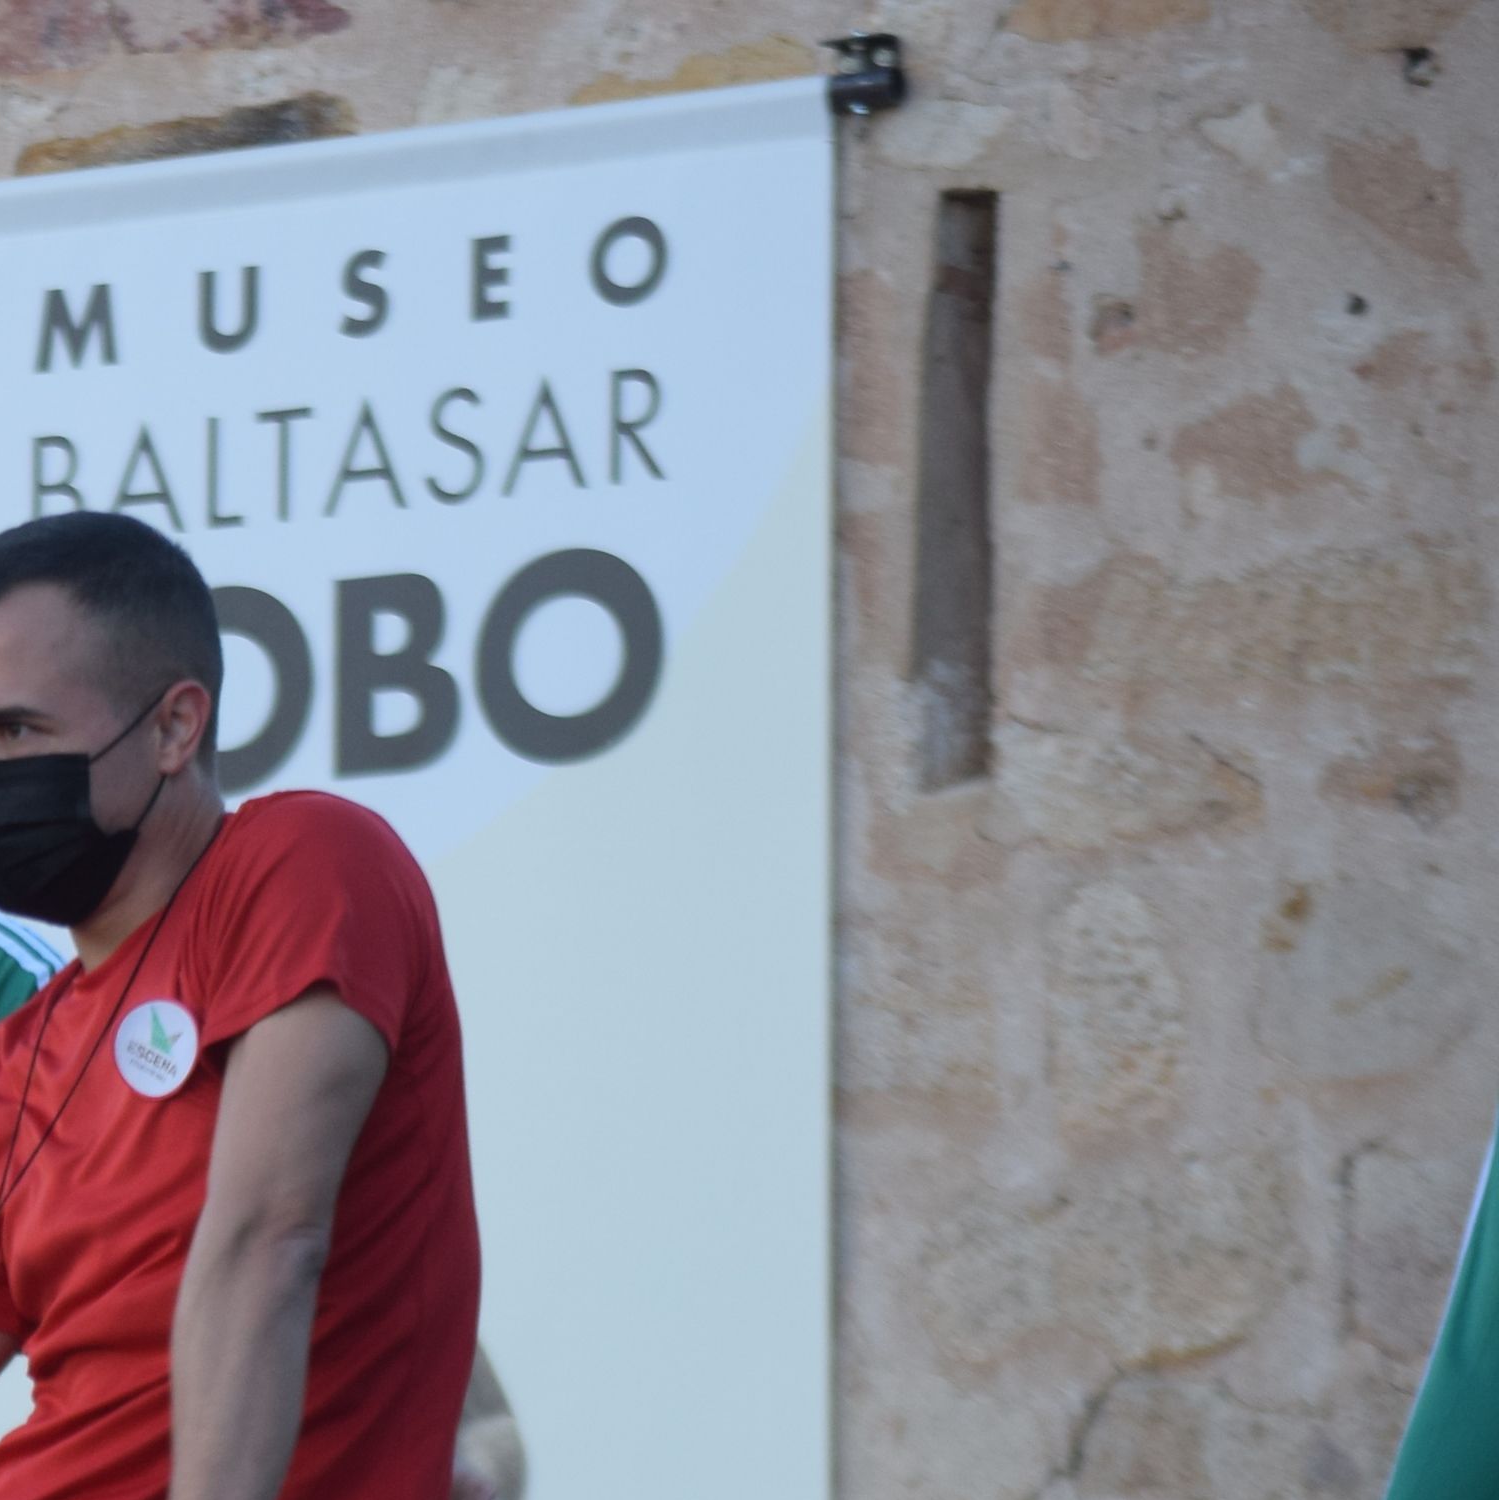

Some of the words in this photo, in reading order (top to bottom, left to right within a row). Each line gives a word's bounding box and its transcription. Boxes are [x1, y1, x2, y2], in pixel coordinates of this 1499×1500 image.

[33, 214, 669, 373] MUSEO
[30, 366, 666, 533] BALTASAR
[214, 547, 664, 798] OBO
[126, 1039, 178, 1079] ESCENA
